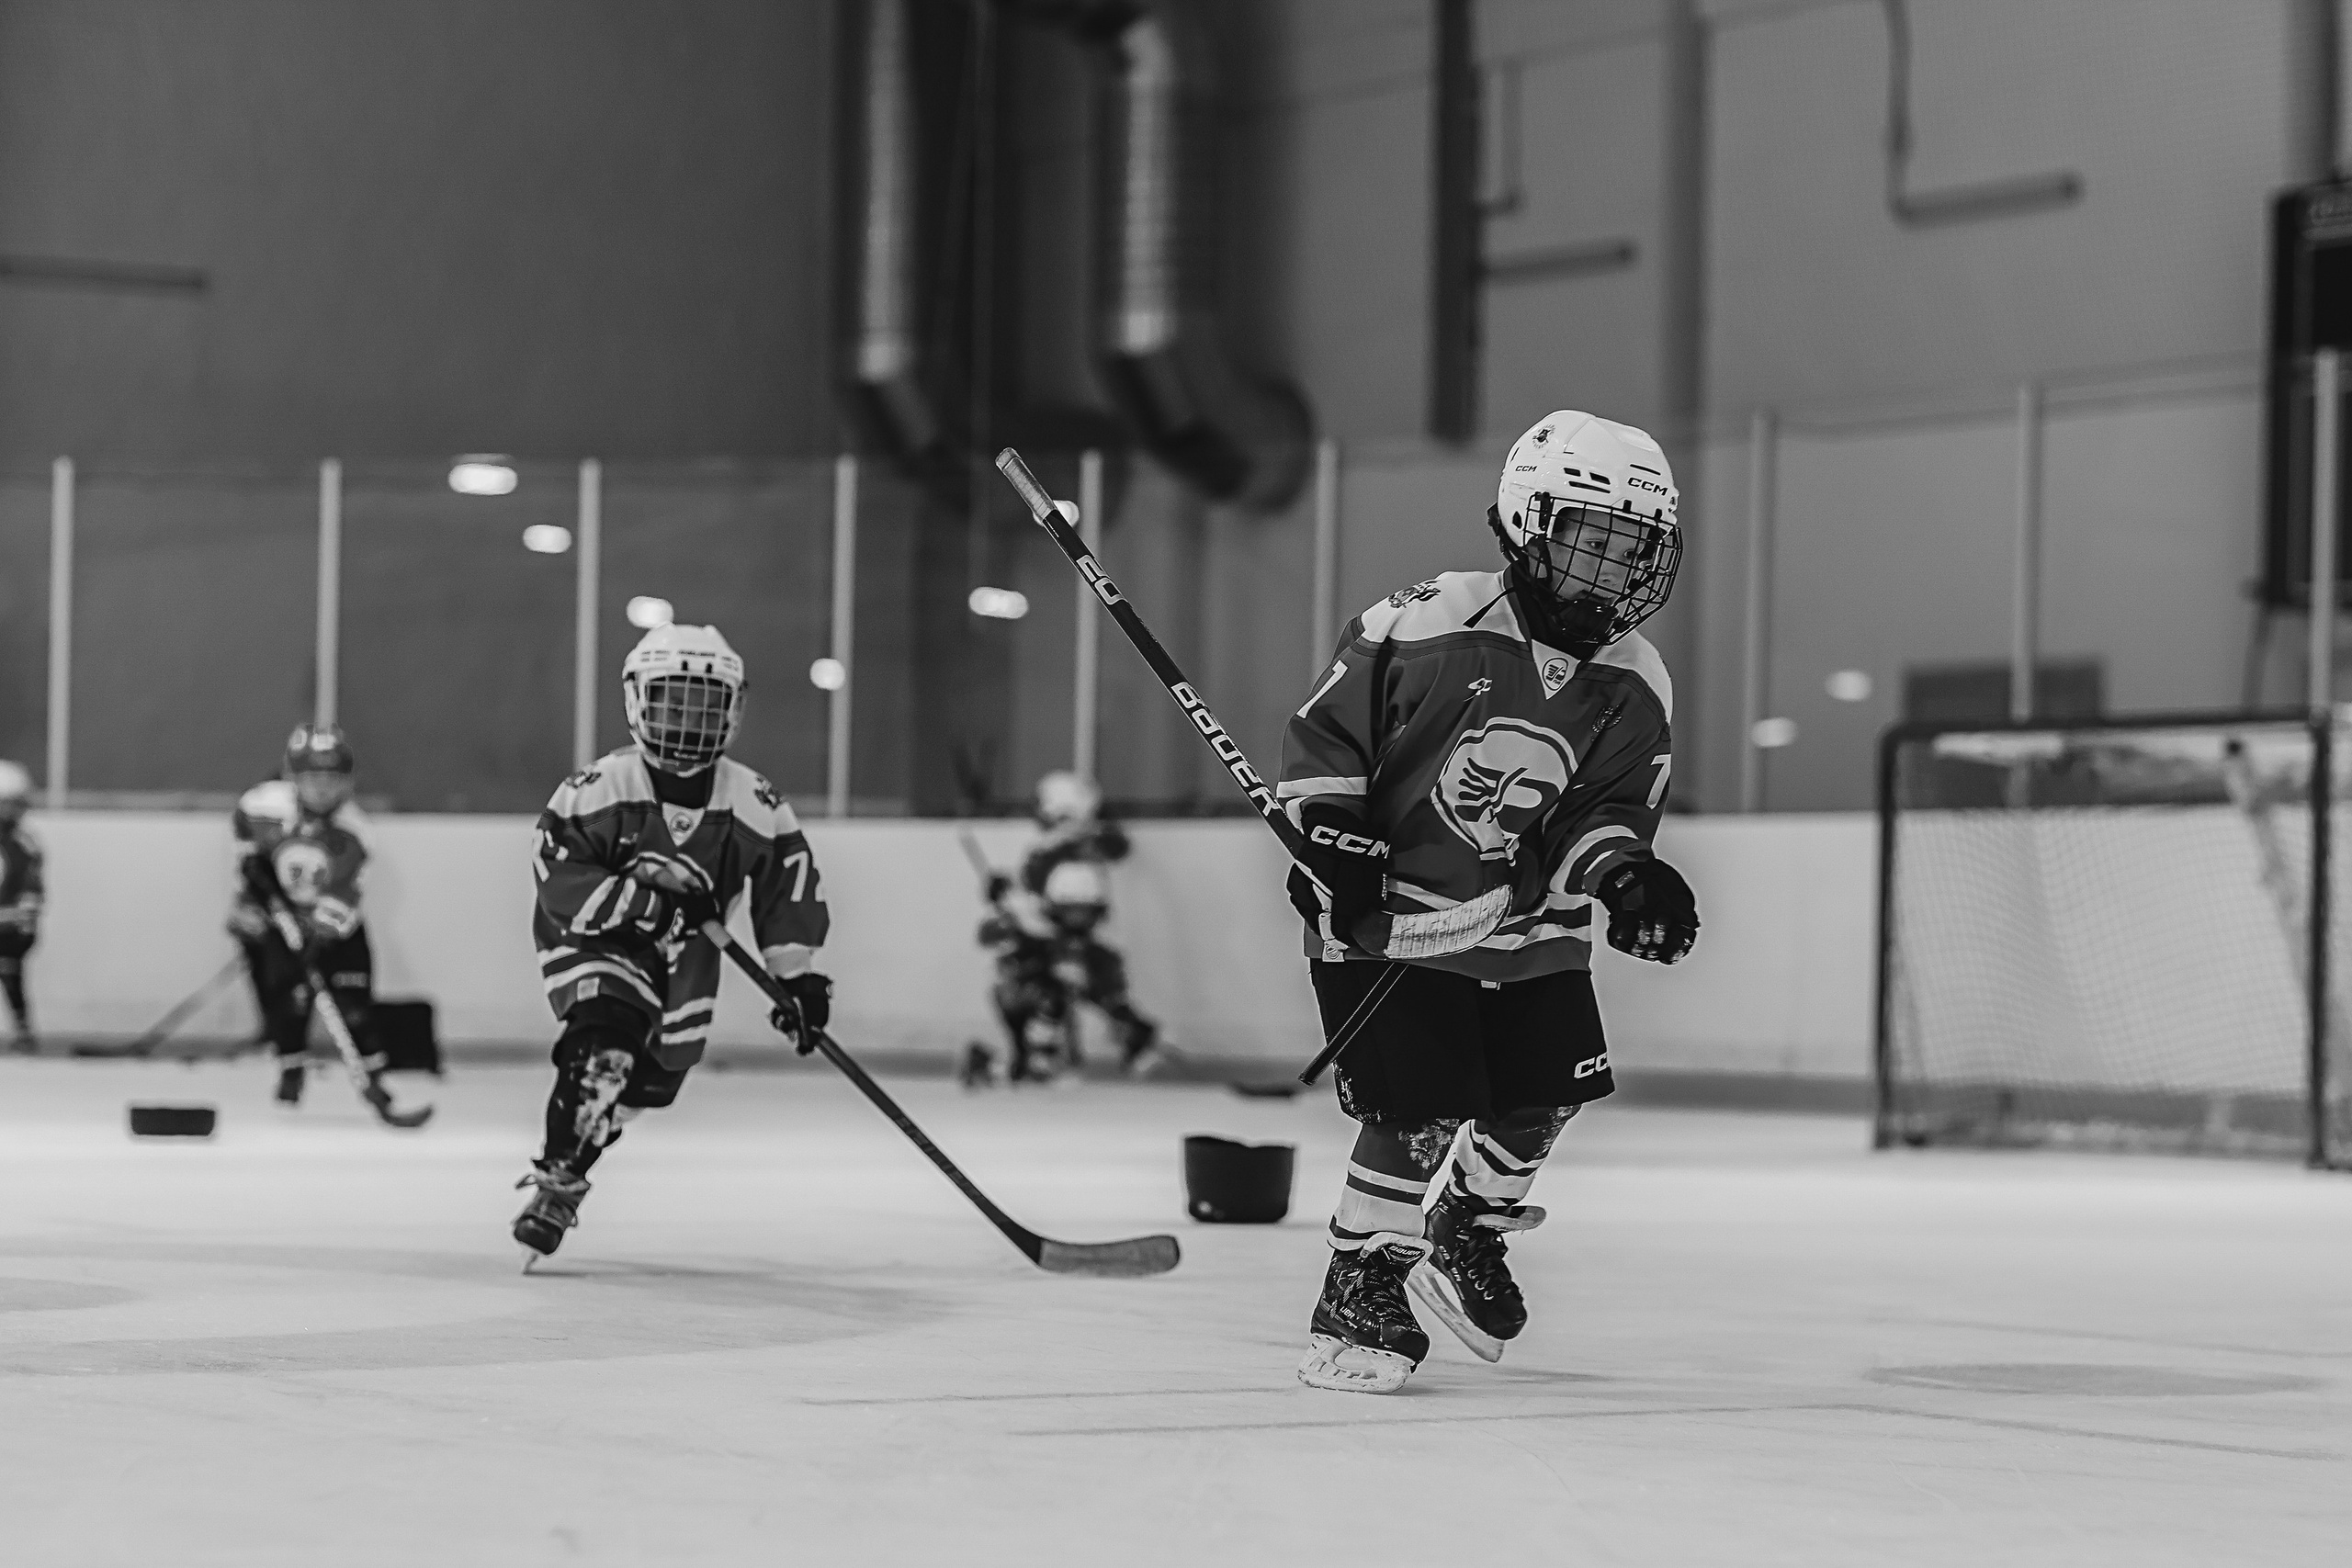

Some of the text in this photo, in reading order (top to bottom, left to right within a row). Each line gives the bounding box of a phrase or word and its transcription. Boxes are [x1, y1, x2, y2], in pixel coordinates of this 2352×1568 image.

[1627, 477, 1668, 496] CCM
[1310, 825, 1391, 859] CCM
[1574, 1052, 1609, 1079] CC
